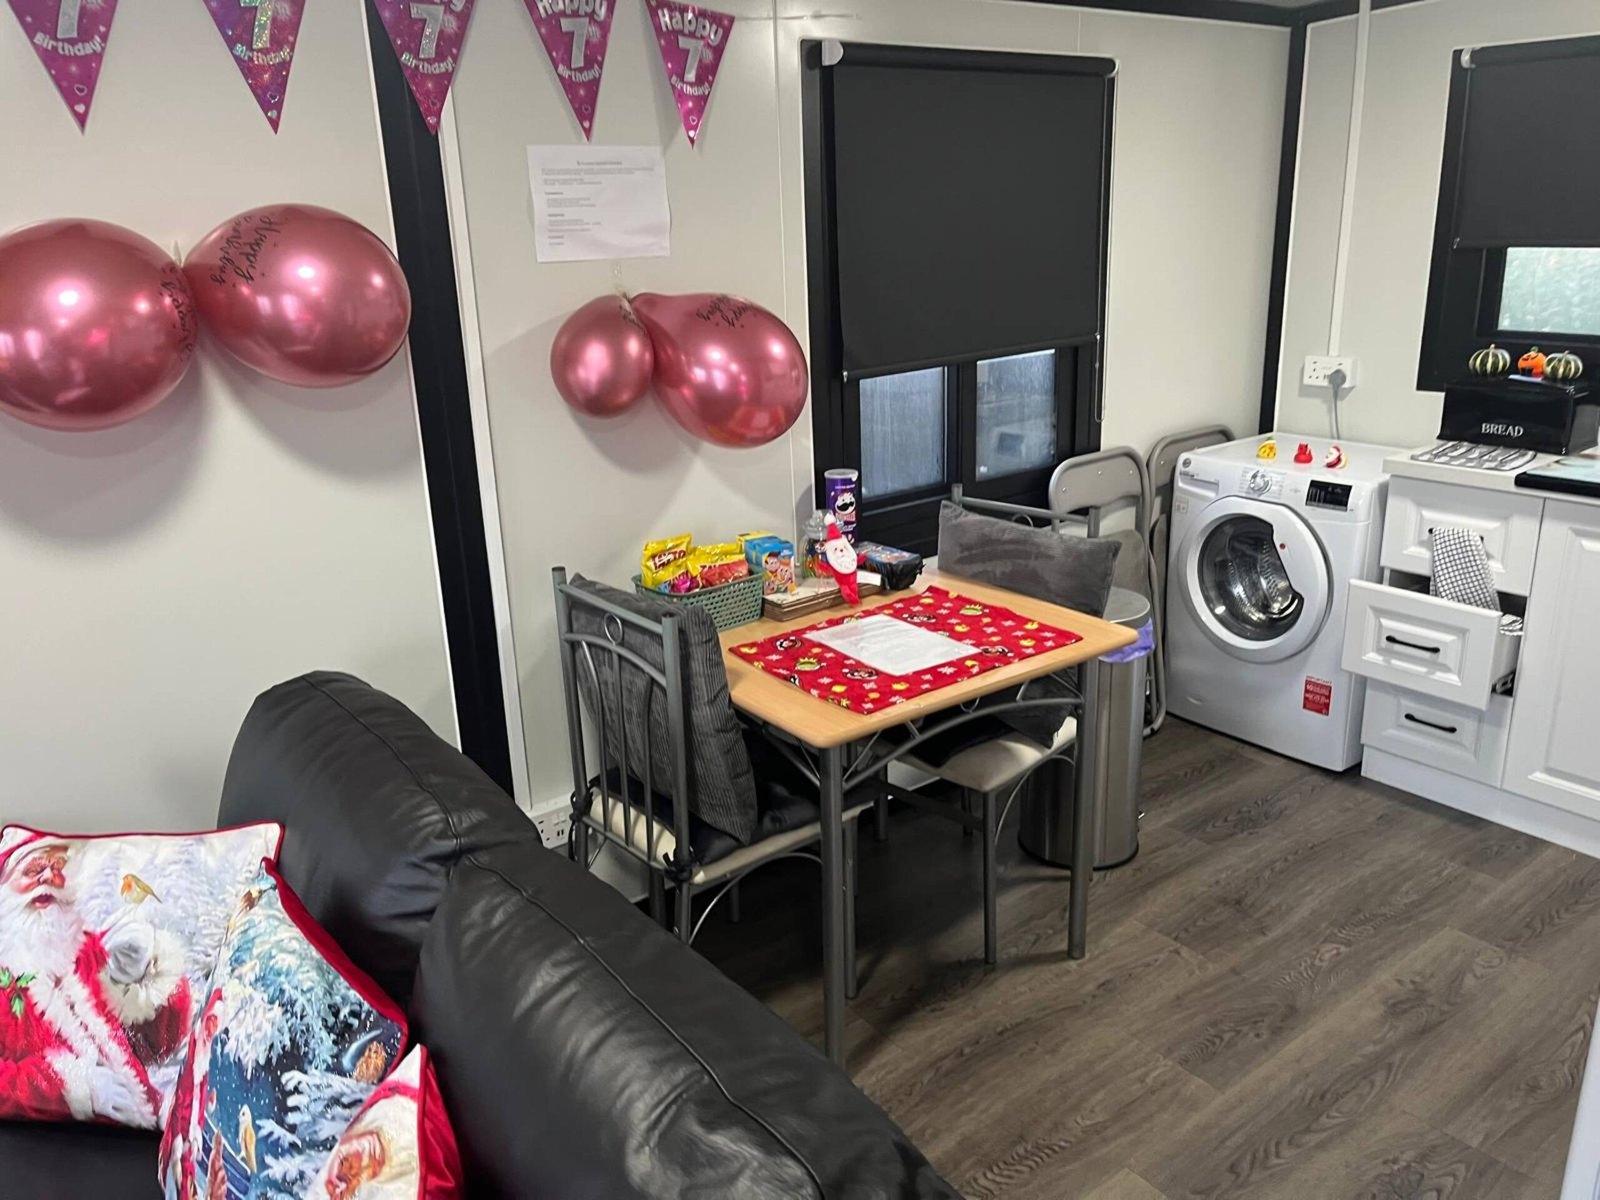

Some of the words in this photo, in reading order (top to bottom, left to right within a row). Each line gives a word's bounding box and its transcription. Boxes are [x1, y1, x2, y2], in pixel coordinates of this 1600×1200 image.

[658, 8, 723, 46] Happy
[34, 32, 104, 56] Birthday!
[401, 51, 455, 74] Birthday!
[1481, 422, 1524, 437] BREAD
